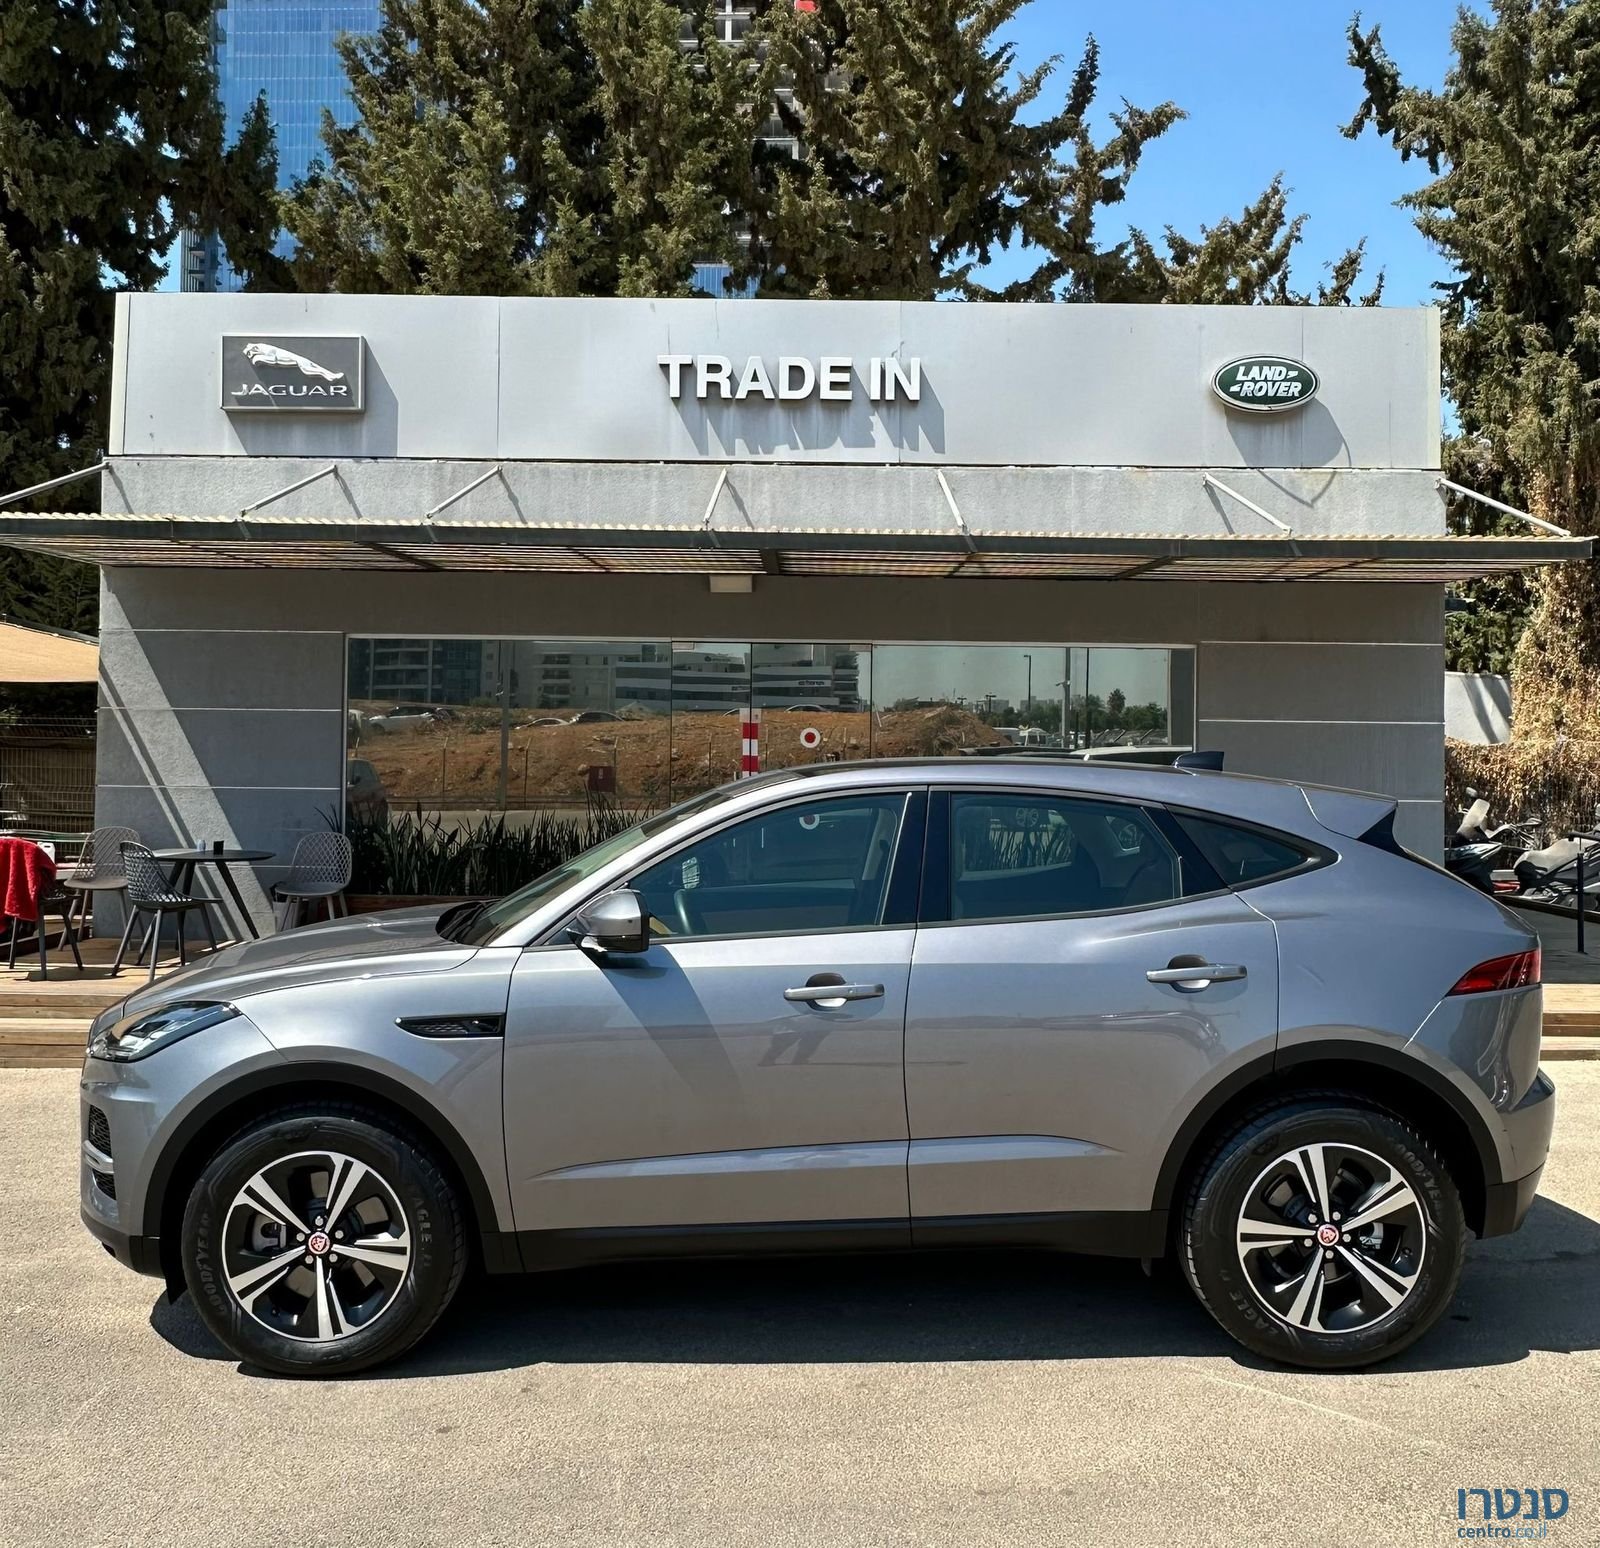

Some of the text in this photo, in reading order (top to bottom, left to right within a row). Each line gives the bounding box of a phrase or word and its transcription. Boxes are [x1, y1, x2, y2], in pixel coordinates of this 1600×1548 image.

[231, 384, 348, 396] JAGUAR
[656, 355, 921, 401] TRADE IN
